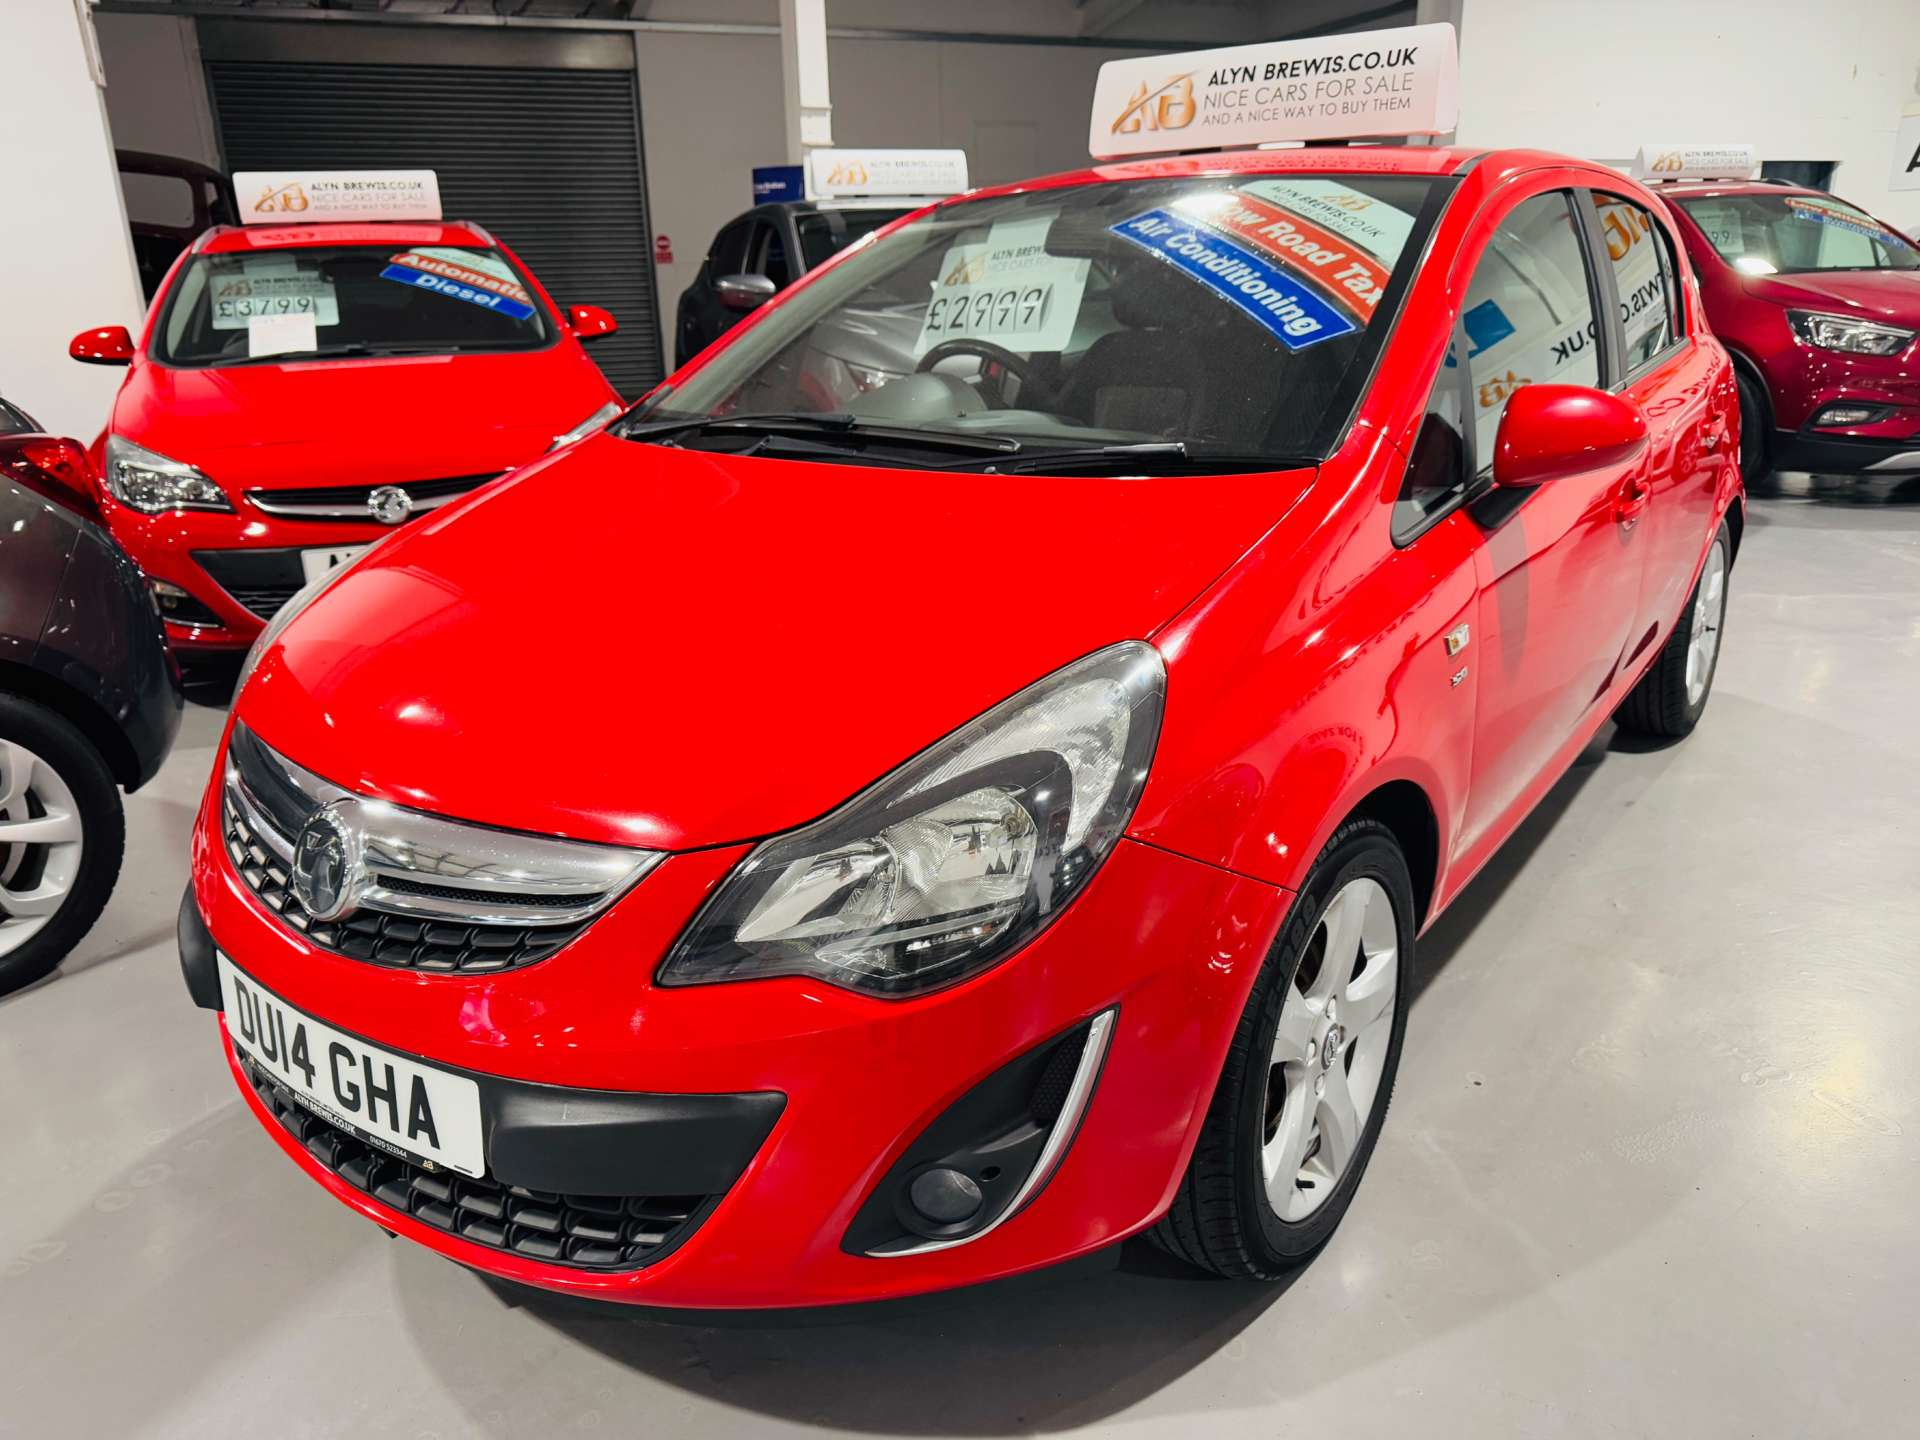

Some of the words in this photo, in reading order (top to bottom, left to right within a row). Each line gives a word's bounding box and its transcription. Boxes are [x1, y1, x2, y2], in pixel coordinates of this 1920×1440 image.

[1207, 66, 1256, 87] ALYN
[1263, 47, 1419, 81] BREWIS.CO.UK
[1202, 89, 1250, 111] NICE
[1254, 82, 1308, 106] CARS
[1315, 78, 1356, 98] FOR
[1362, 71, 1416, 95] SALE
[1201, 112, 1231, 127] AND
[1233, 112, 1246, 125] A
[1248, 107, 1279, 123] NICE
[1283, 104, 1317, 120] WAY
[1319, 102, 1338, 117] TO
[1341, 99, 1369, 115] BUY
[1372, 96, 1412, 112] THEM
[399, 254, 531, 302] Automatic
[1128, 217, 1174, 237] Air
[1164, 231, 1323, 337] Conditioning
[1257, 219, 1346, 268] Road
[1332, 262, 1384, 307] Tax
[219, 297, 311, 318] £3799
[415, 273, 503, 308] Diesel
[233, 974, 316, 1090] DU14
[328, 1041, 442, 1151] GHA
